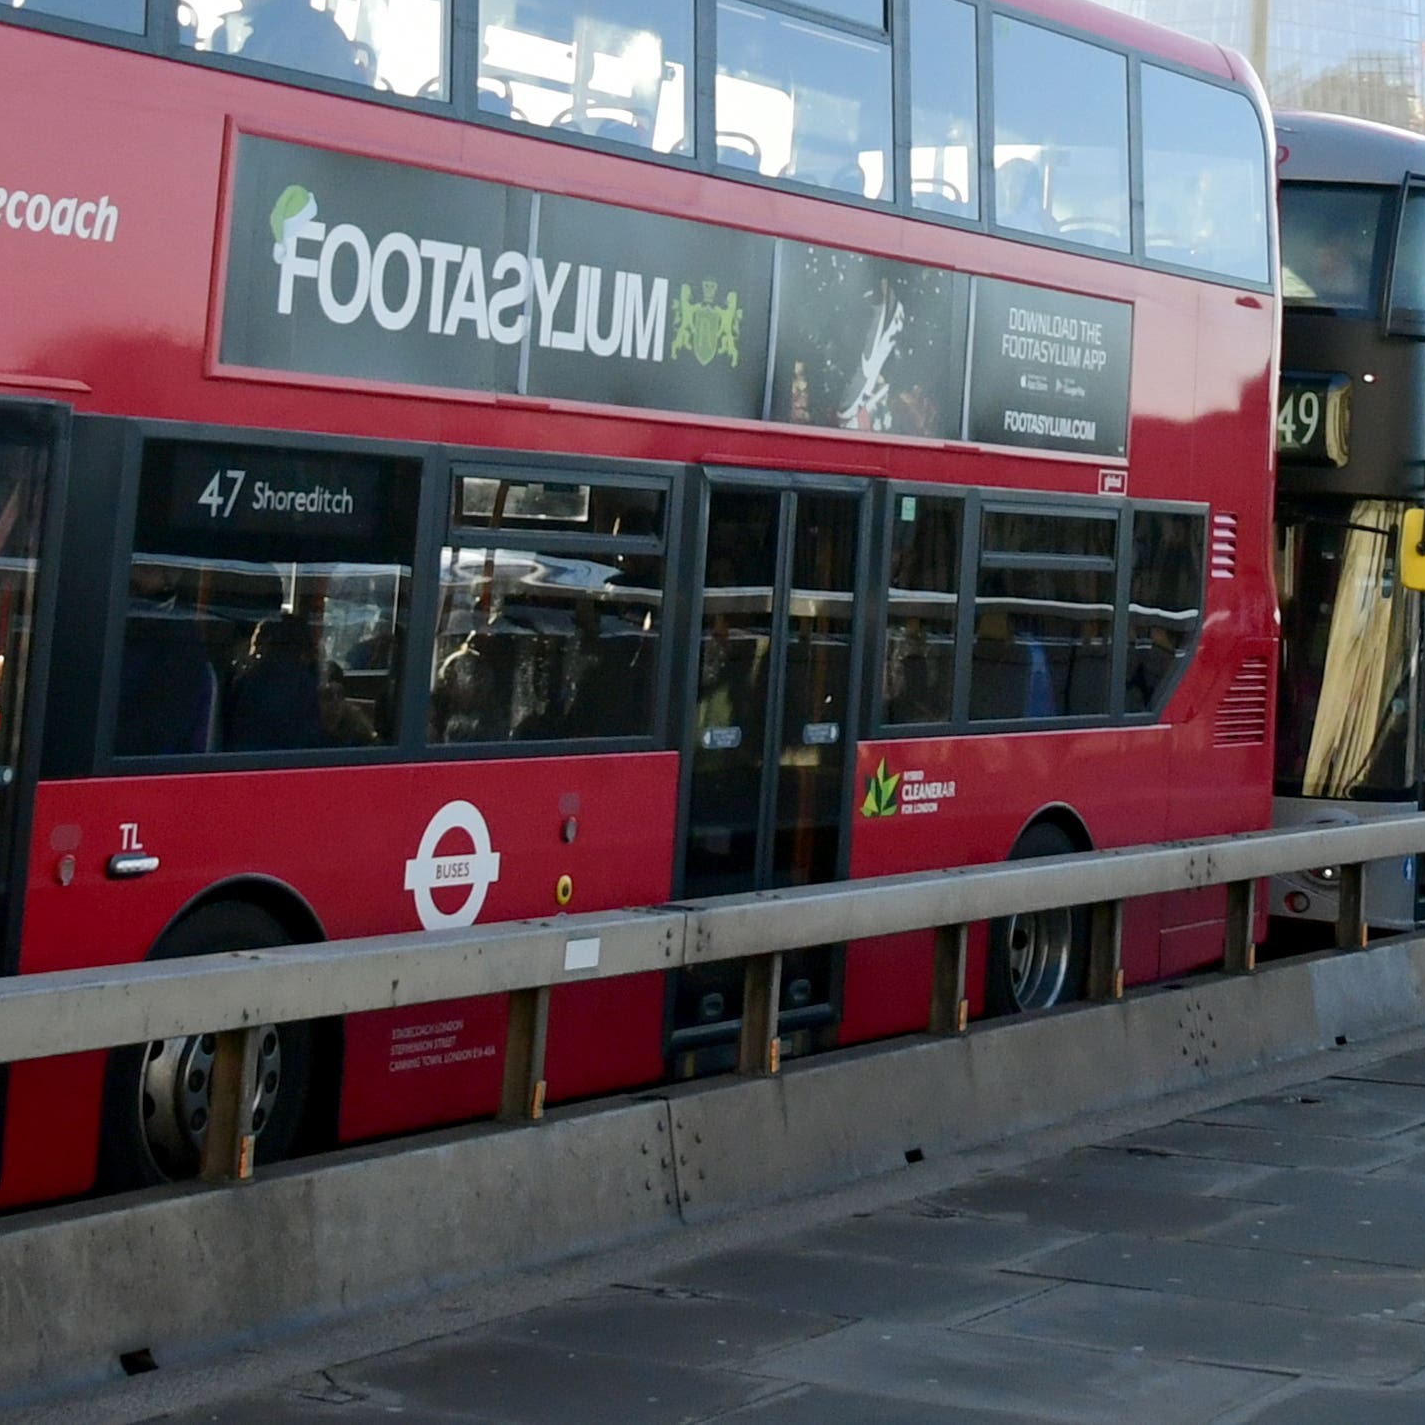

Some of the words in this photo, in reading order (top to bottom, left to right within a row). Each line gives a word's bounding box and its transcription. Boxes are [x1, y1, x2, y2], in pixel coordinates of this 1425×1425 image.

[276, 219, 669, 364] FOOTASYLUM
[1008, 307, 1078, 341] DOWNLOAD
[1080, 320, 1103, 346] THE
[1001, 334, 1081, 370] FOOTASYLUM
[1082, 348, 1107, 372] APP
[1004, 410, 1097, 441] FOOTASYLUM.COM
[197, 469, 246, 518] 47
[251, 481, 354, 514] Shoreditch
[119, 823, 143, 850] TL
[435, 863, 470, 879] BUSES
